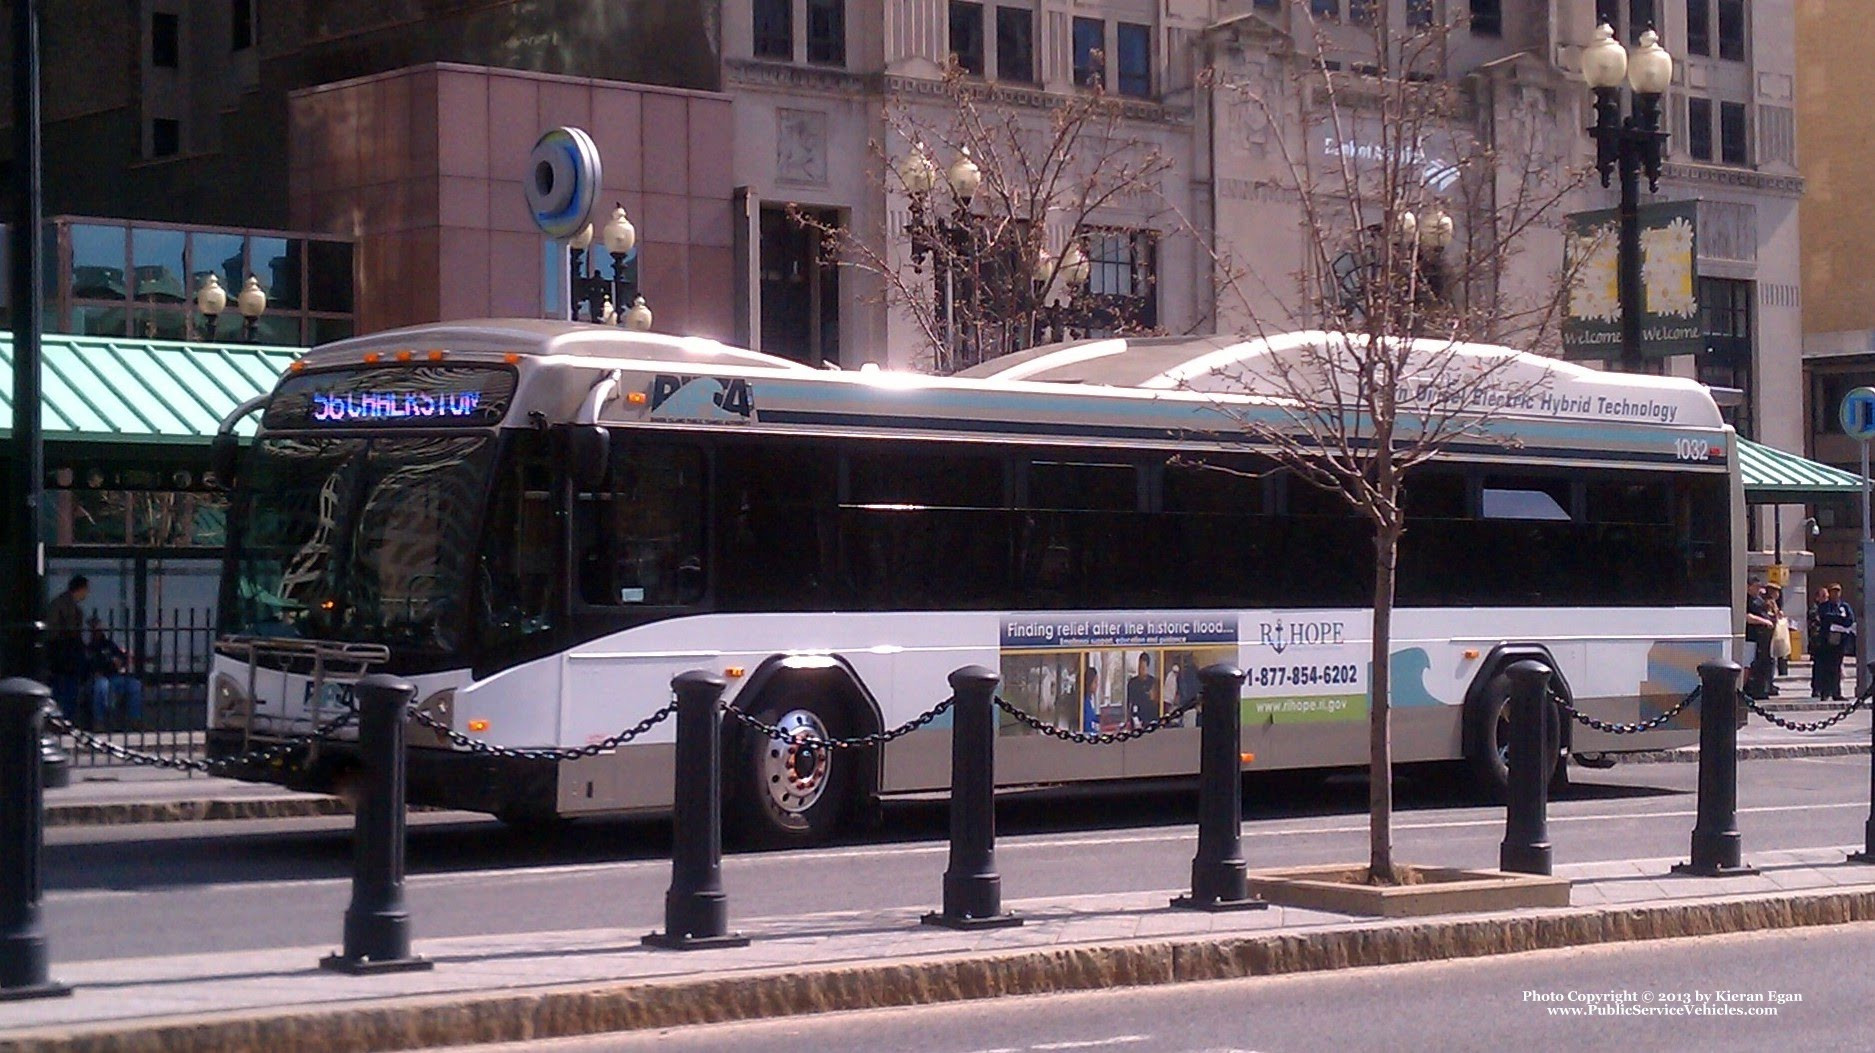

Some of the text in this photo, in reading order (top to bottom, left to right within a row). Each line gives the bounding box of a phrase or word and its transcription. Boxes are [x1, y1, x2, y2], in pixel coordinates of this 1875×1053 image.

[1564, 330, 1623, 344] Welcome
[1643, 326, 1700, 341] Welcome
[1541, 393, 1591, 415] Hybrid
[1598, 397, 1678, 422] Technology
[1675, 438, 1709, 460] 1032
[1007, 621, 1054, 640] Finding
[1057, 621, 1089, 636] relief
[1092, 621, 1122, 636] after
[1124, 621, 1144, 635] the
[1147, 619, 1190, 634] historic
[1290, 622, 1344, 645] HOPE
[1246, 664, 1357, 687] 1-877-854-6202
[1256, 699, 1348, 714] www.rihope.ri.gov
